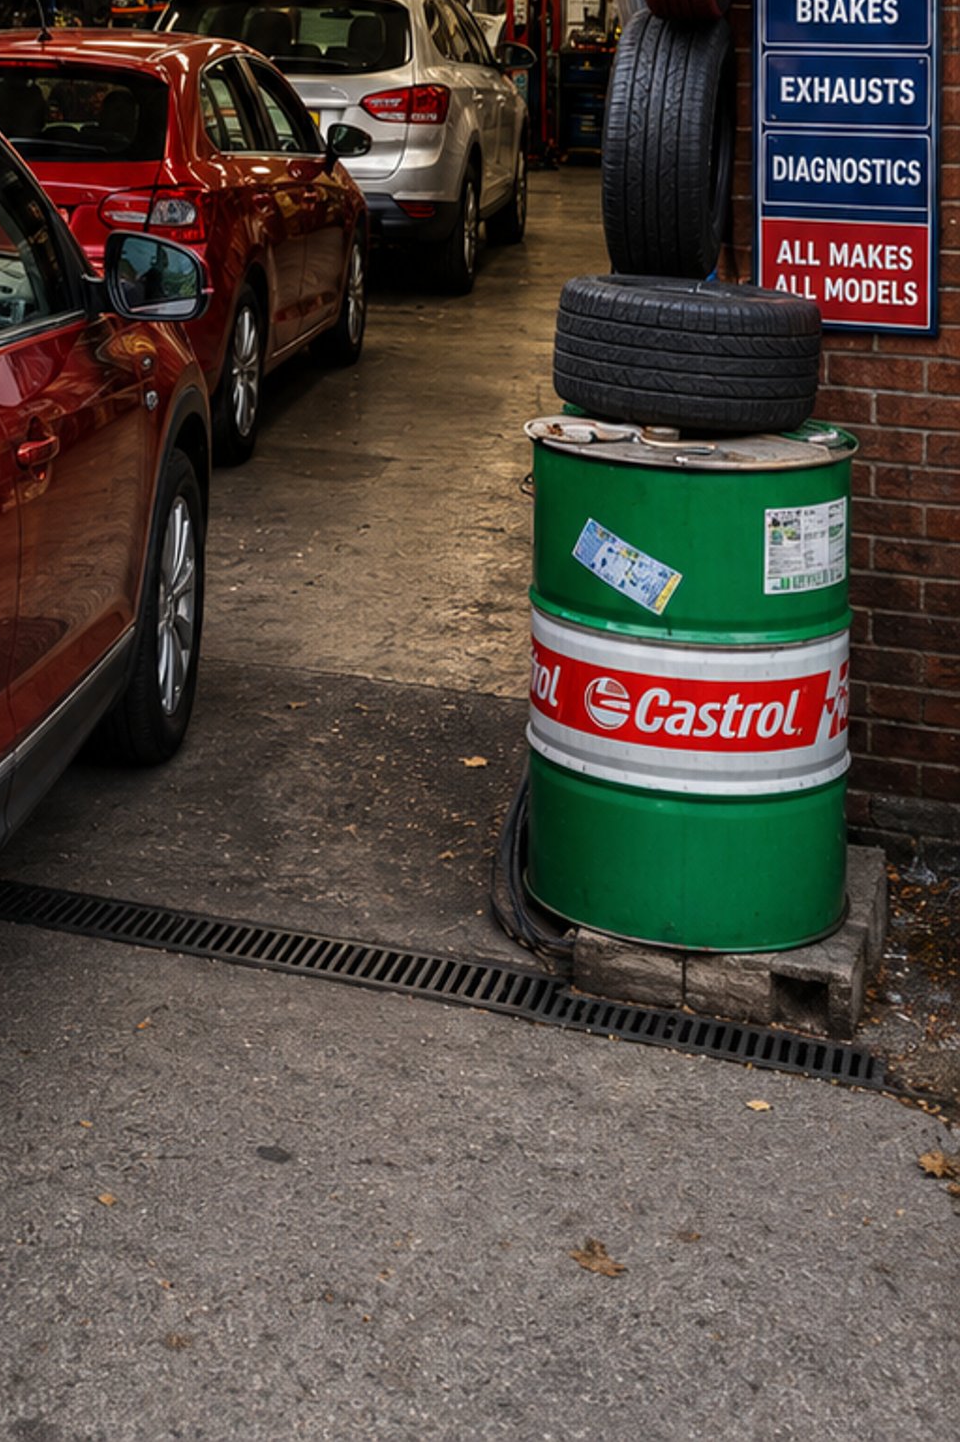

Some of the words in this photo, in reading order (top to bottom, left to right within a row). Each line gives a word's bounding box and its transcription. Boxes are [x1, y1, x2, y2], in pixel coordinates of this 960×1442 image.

[780, 76, 915, 105] EXHAUSTS
[772, 155, 922, 186] DIAGNOSTICS
[776, 239, 821, 266] ALL
[829, 242, 913, 271] MAKES
[775, 273, 817, 300] ALL
[824, 276, 919, 306] MODELS
[634, 687, 800, 739] Castrol
